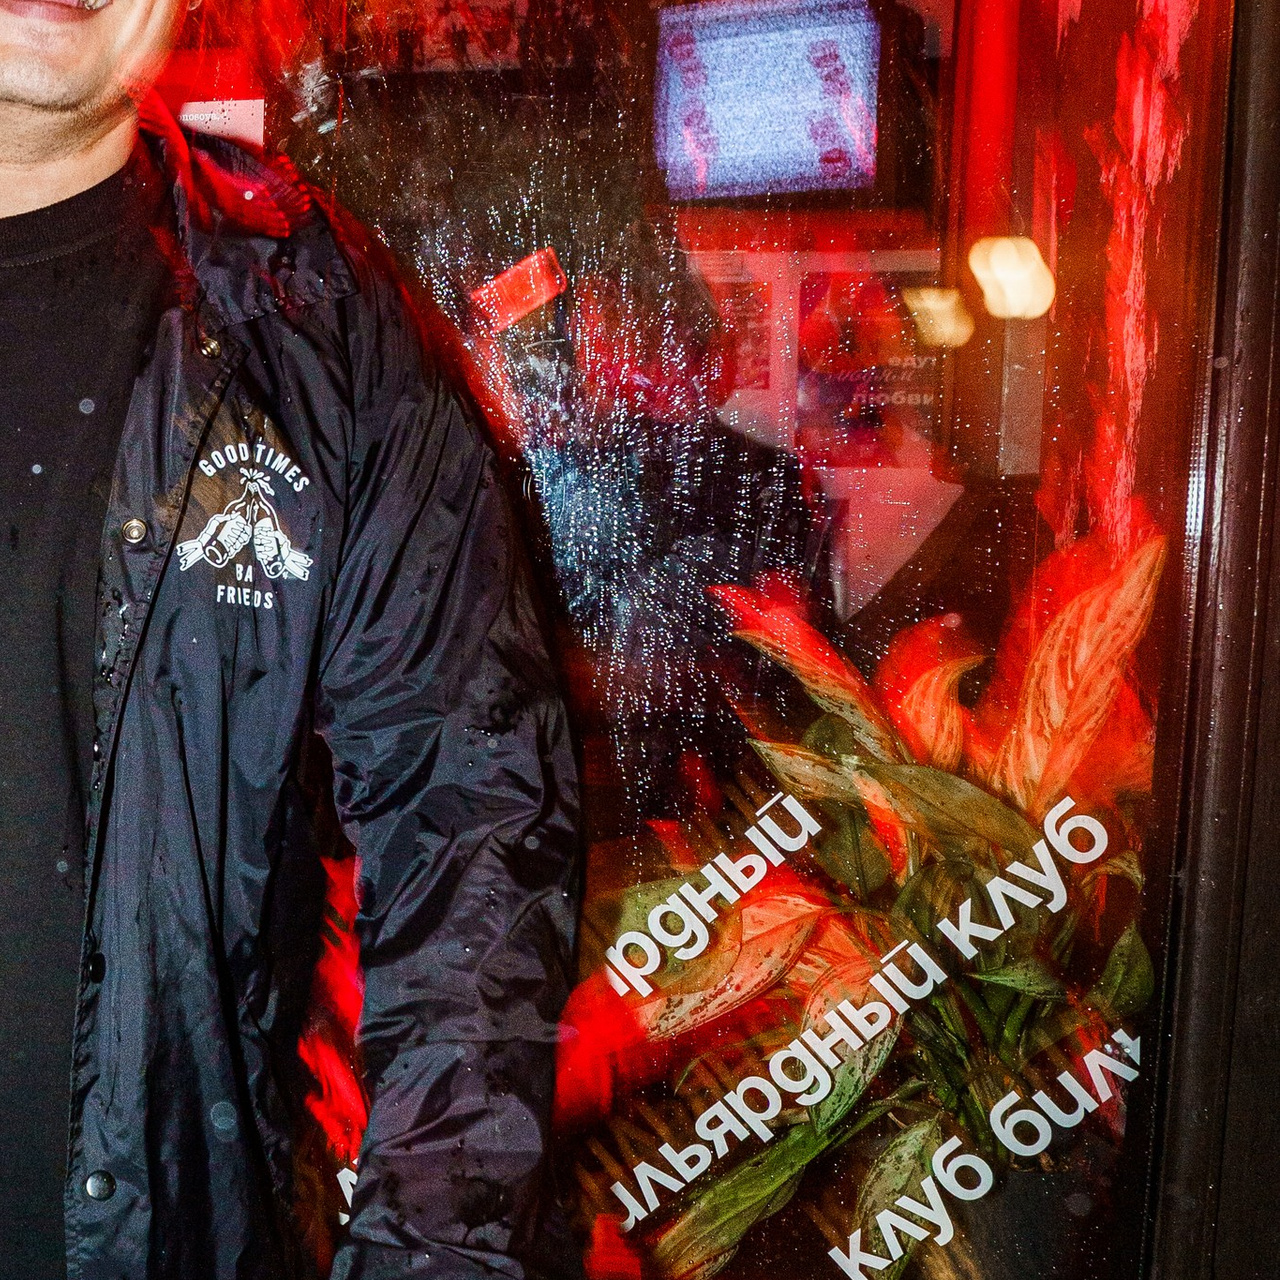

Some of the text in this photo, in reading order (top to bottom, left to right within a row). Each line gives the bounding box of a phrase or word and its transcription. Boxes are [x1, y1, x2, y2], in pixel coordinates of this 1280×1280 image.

[198, 442, 310, 492] GOOD TIMES
[235, 563, 253, 582] BA
[216, 585, 274, 609] FRIEDS
[936, 796, 1109, 961] клуб
